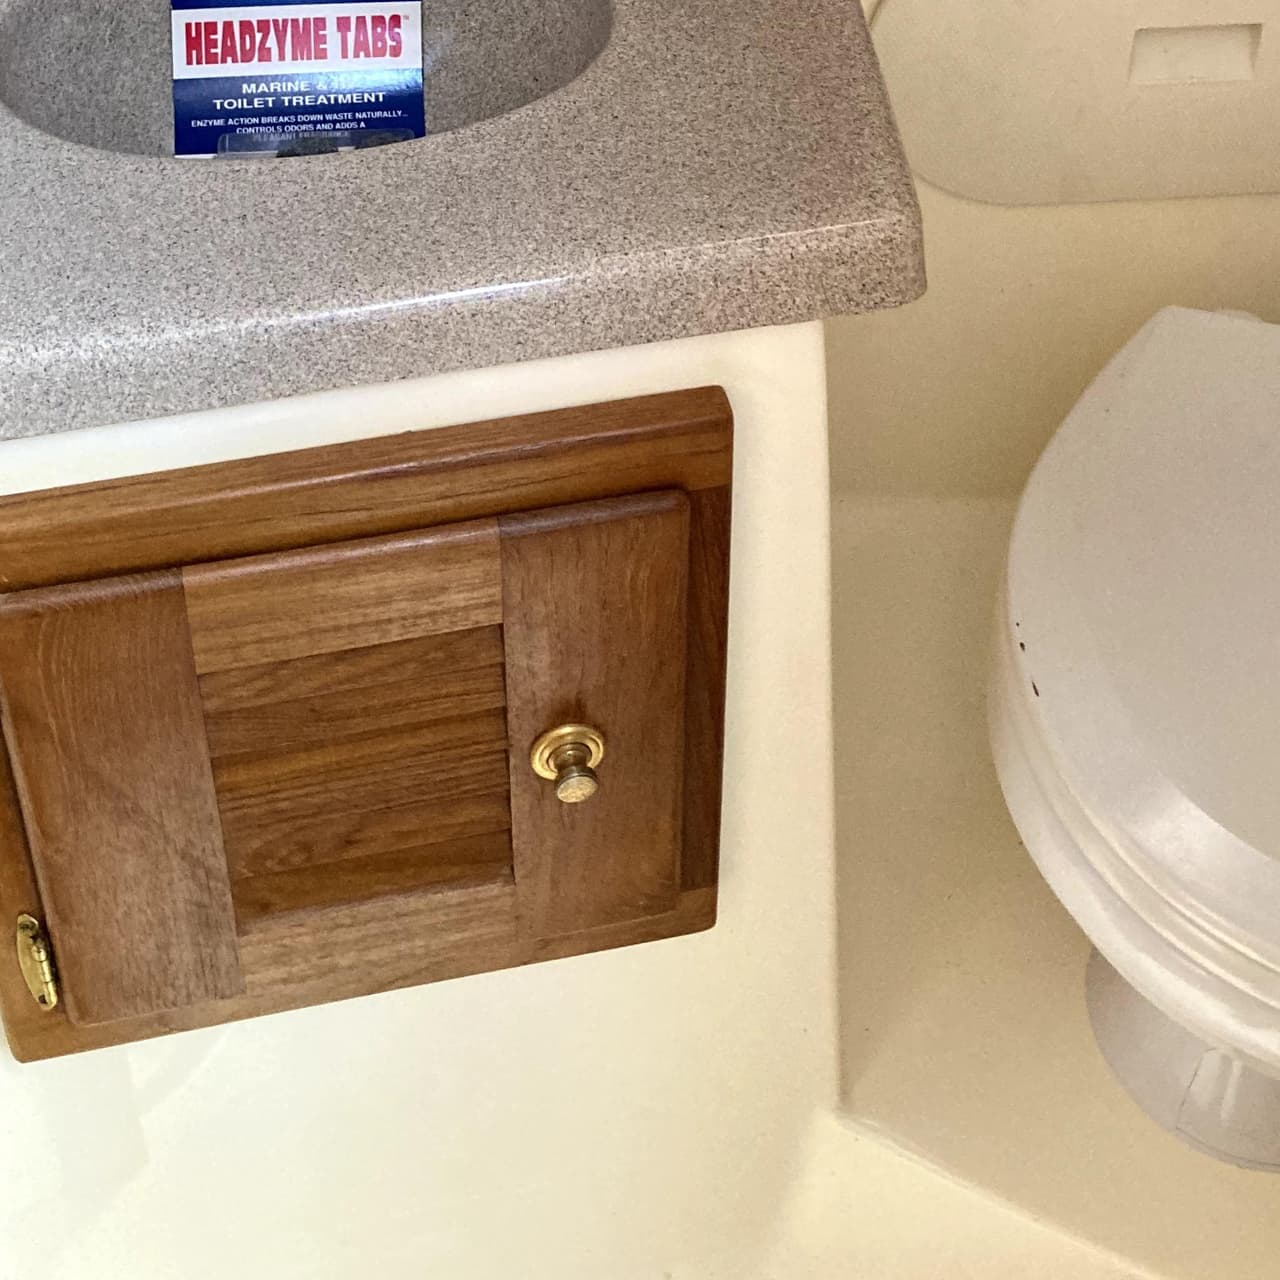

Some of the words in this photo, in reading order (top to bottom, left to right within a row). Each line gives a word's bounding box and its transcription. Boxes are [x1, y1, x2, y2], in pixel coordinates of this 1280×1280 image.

[184, 16, 328, 66] HEADZYME
[336, 14, 403, 60] TABS
[242, 80, 311, 95] MARINE
[212, 96, 277, 110] TOILET
[281, 91, 387, 107] TREATMENT
[191, 118, 226, 128] ENZYME
[227, 116, 260, 126] ACTION
[261, 114, 296, 124] BREAKS
[297, 113, 324, 122] DOWN
[325, 112, 354, 121] WASTE
[236, 124, 283, 135] CONTROLS
[284, 123, 315, 132] ODORS
[316, 122, 334, 131] AND
[335, 121, 359, 130] ADDS
[359, 120, 367, 129] A
